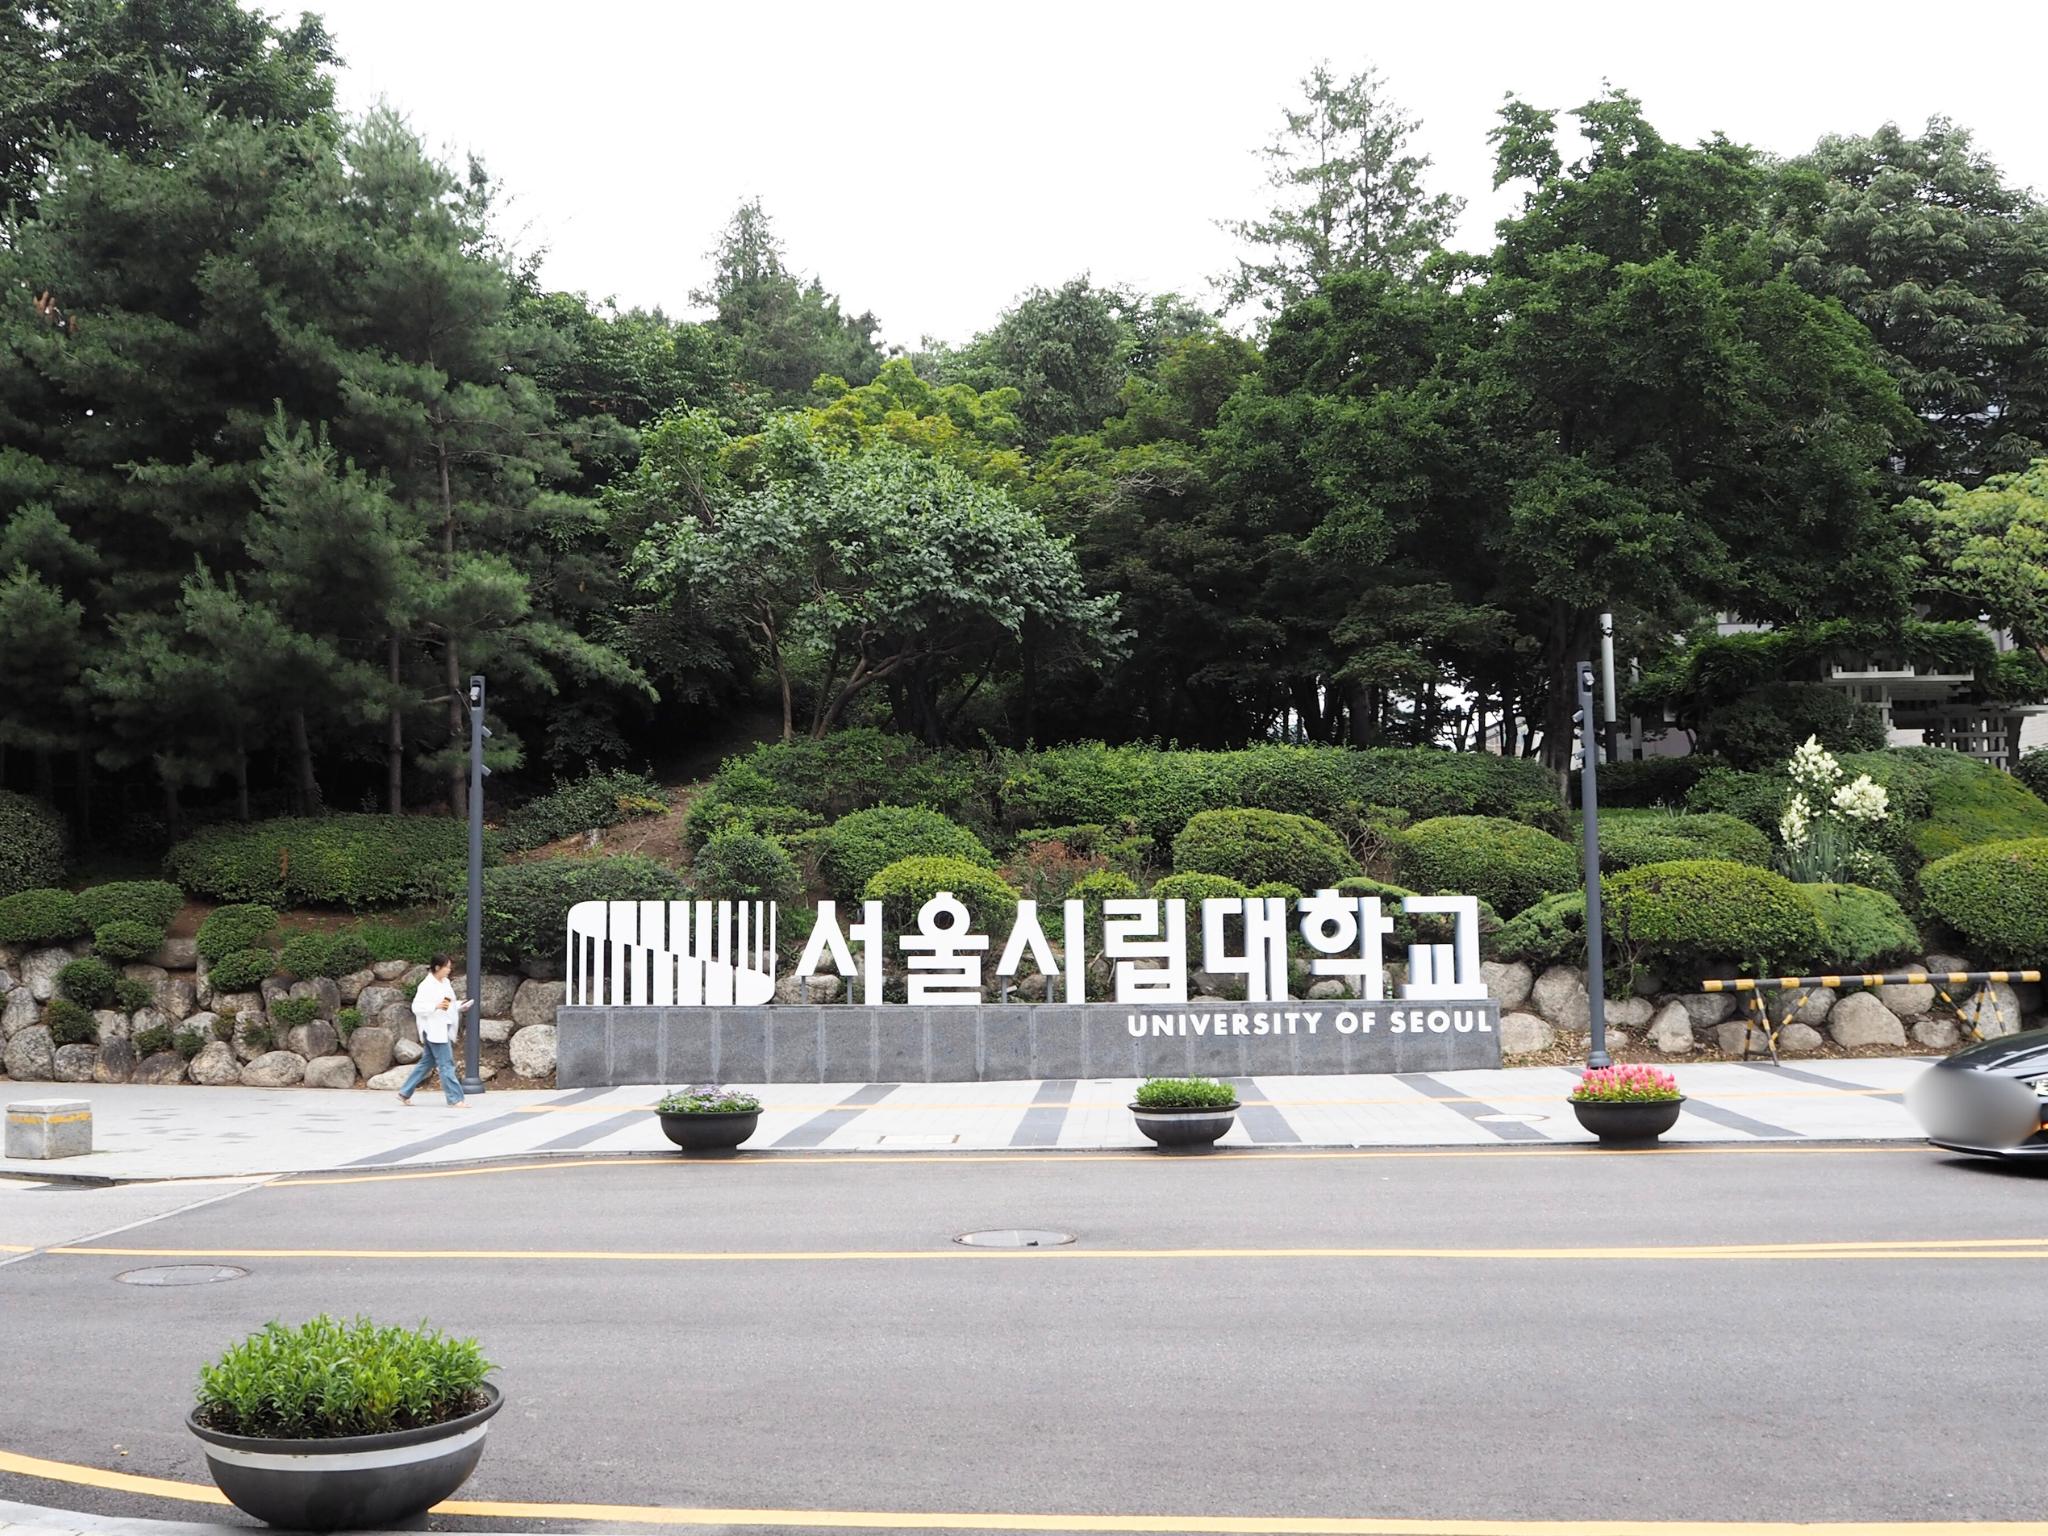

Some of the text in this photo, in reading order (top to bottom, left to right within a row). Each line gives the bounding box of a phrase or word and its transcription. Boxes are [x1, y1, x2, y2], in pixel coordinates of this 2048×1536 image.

[795, 888, 1488, 1006] 서울시립대학교
[1127, 1010, 1493, 1038] UNIVERSITY OF SEOUL
